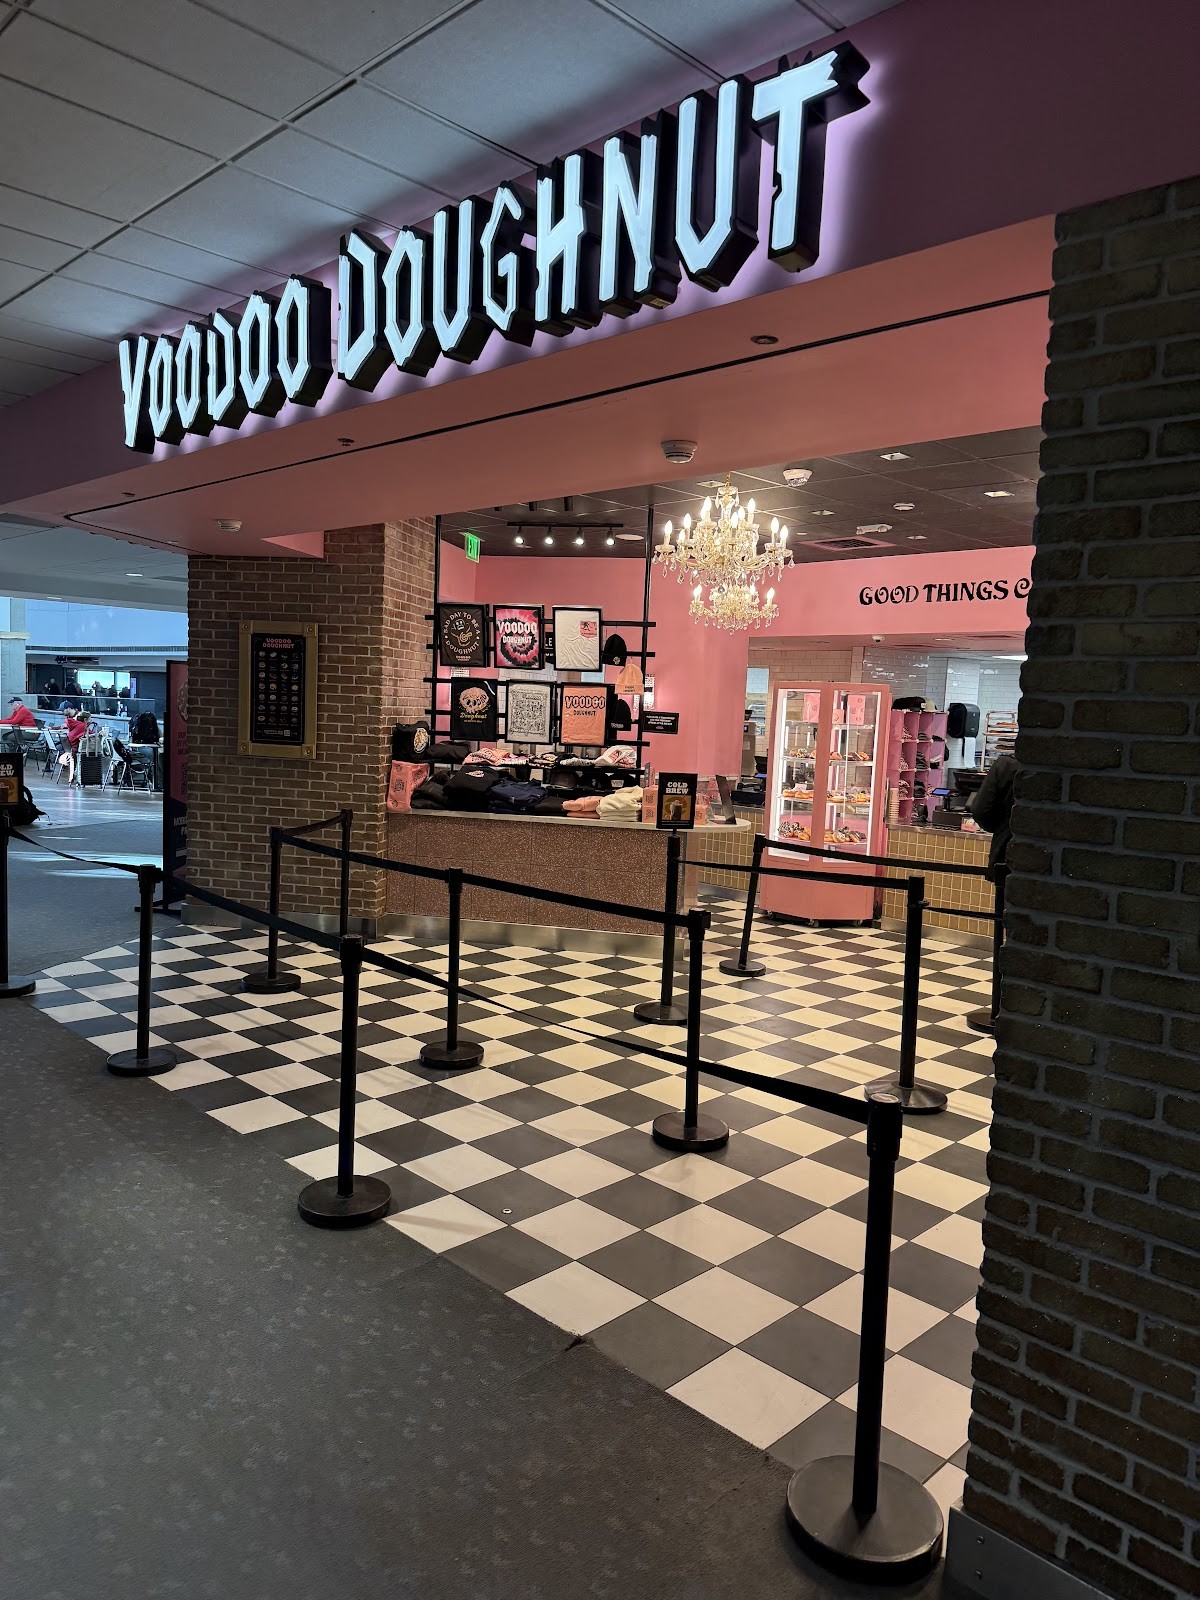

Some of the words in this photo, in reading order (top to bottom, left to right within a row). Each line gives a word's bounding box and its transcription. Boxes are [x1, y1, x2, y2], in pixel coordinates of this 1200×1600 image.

[118, 275, 314, 450] VOODOO
[336, 48, 850, 386] DOUGHNUT
[859, 584, 919, 606] GOOD
[922, 579, 1009, 604] THINGS
[443, 619, 451, 633] BAD
[449, 611, 462, 621] DAY
[463, 611, 472, 620] TO
[471, 618, 480, 628] BE
[497, 621, 538, 634] VOODOO
[502, 635, 533, 644] DOUGHNUT
[445, 641, 480, 655] DOUGHNUT
[565, 695, 606, 710] VOODOO
